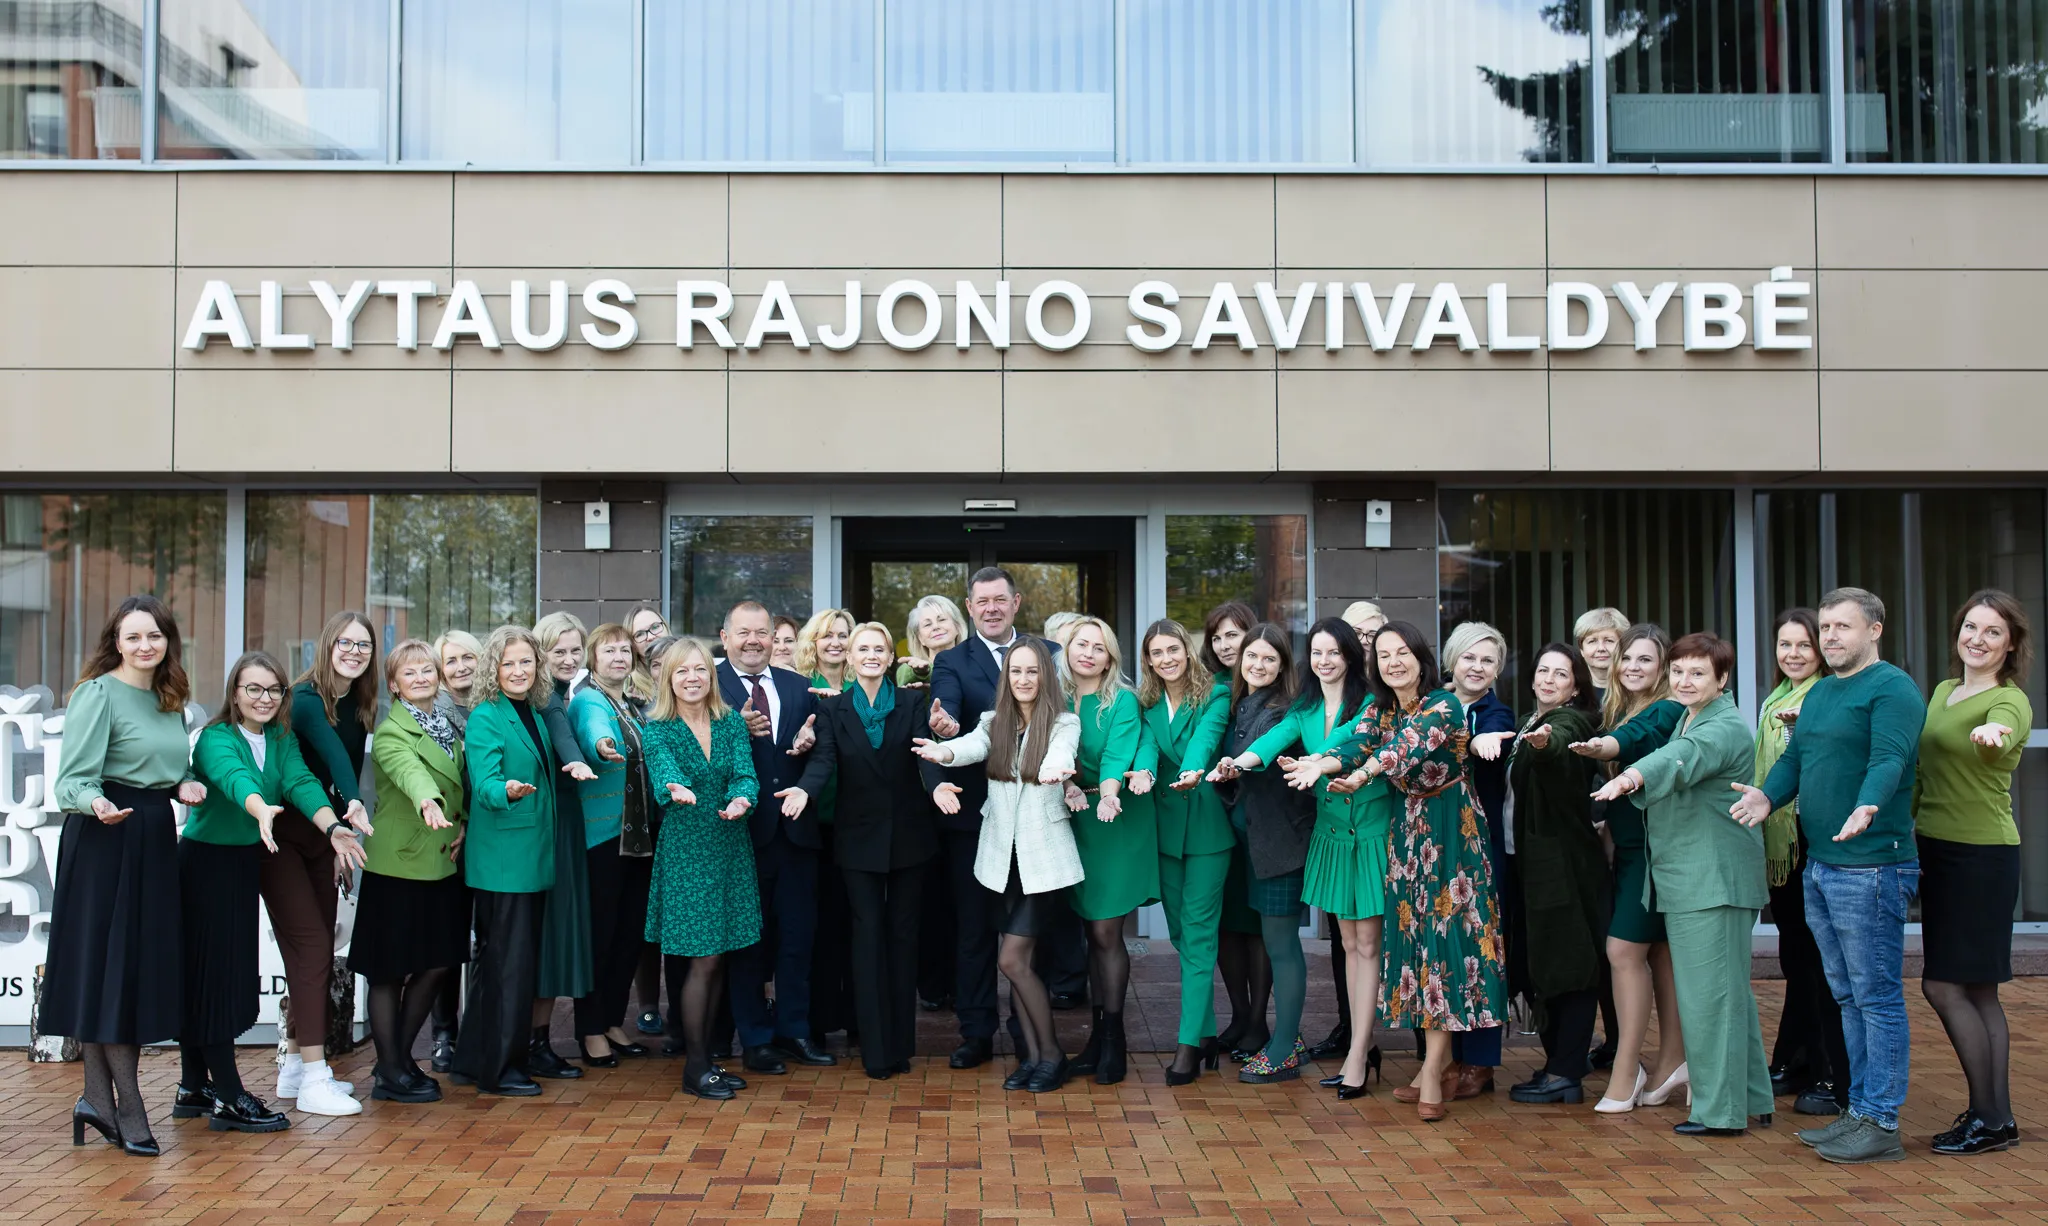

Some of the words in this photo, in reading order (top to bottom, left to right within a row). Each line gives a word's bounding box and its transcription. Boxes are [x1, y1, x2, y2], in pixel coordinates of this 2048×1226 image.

[182, 279, 639, 351] ALYTAUS
[675, 279, 1092, 352] RAJONO
[1125, 265, 1813, 353] SAVIVALDYBĖ
